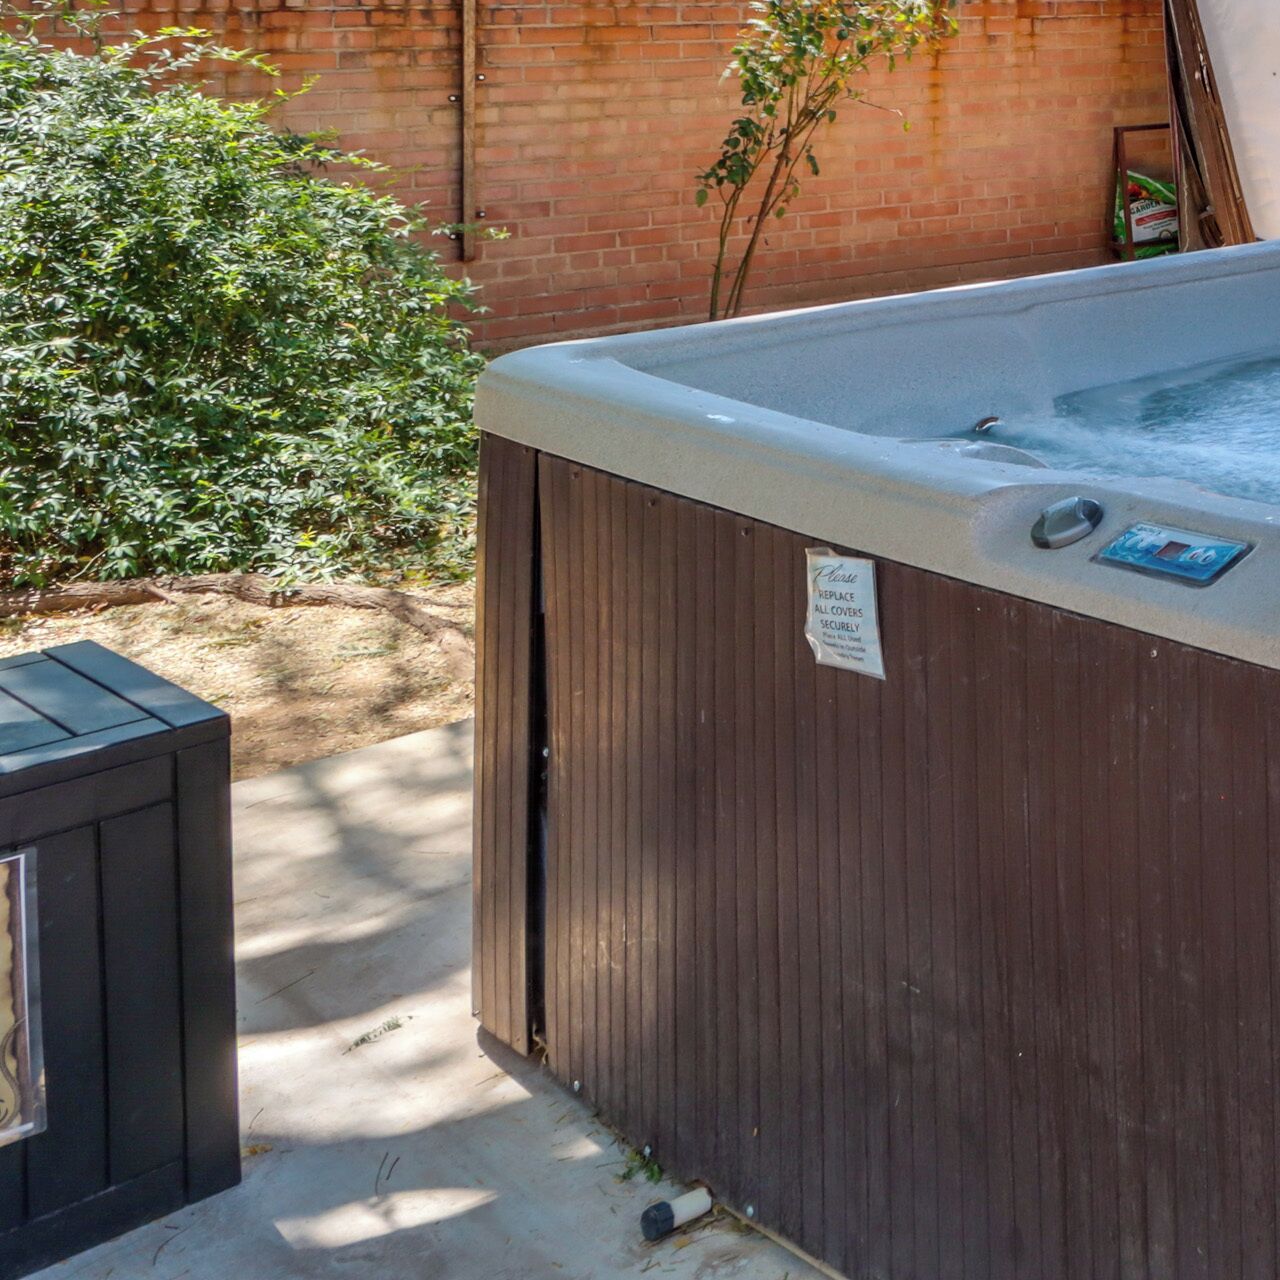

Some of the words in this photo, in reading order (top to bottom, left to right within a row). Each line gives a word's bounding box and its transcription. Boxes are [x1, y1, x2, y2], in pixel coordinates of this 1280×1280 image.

[813, 564, 858, 584] Please
[818, 589, 855, 602] REPLACE
[815, 604, 829, 614] ALL
[831, 606, 863, 618] COVERS
[820, 619, 860, 633] SECURELY
